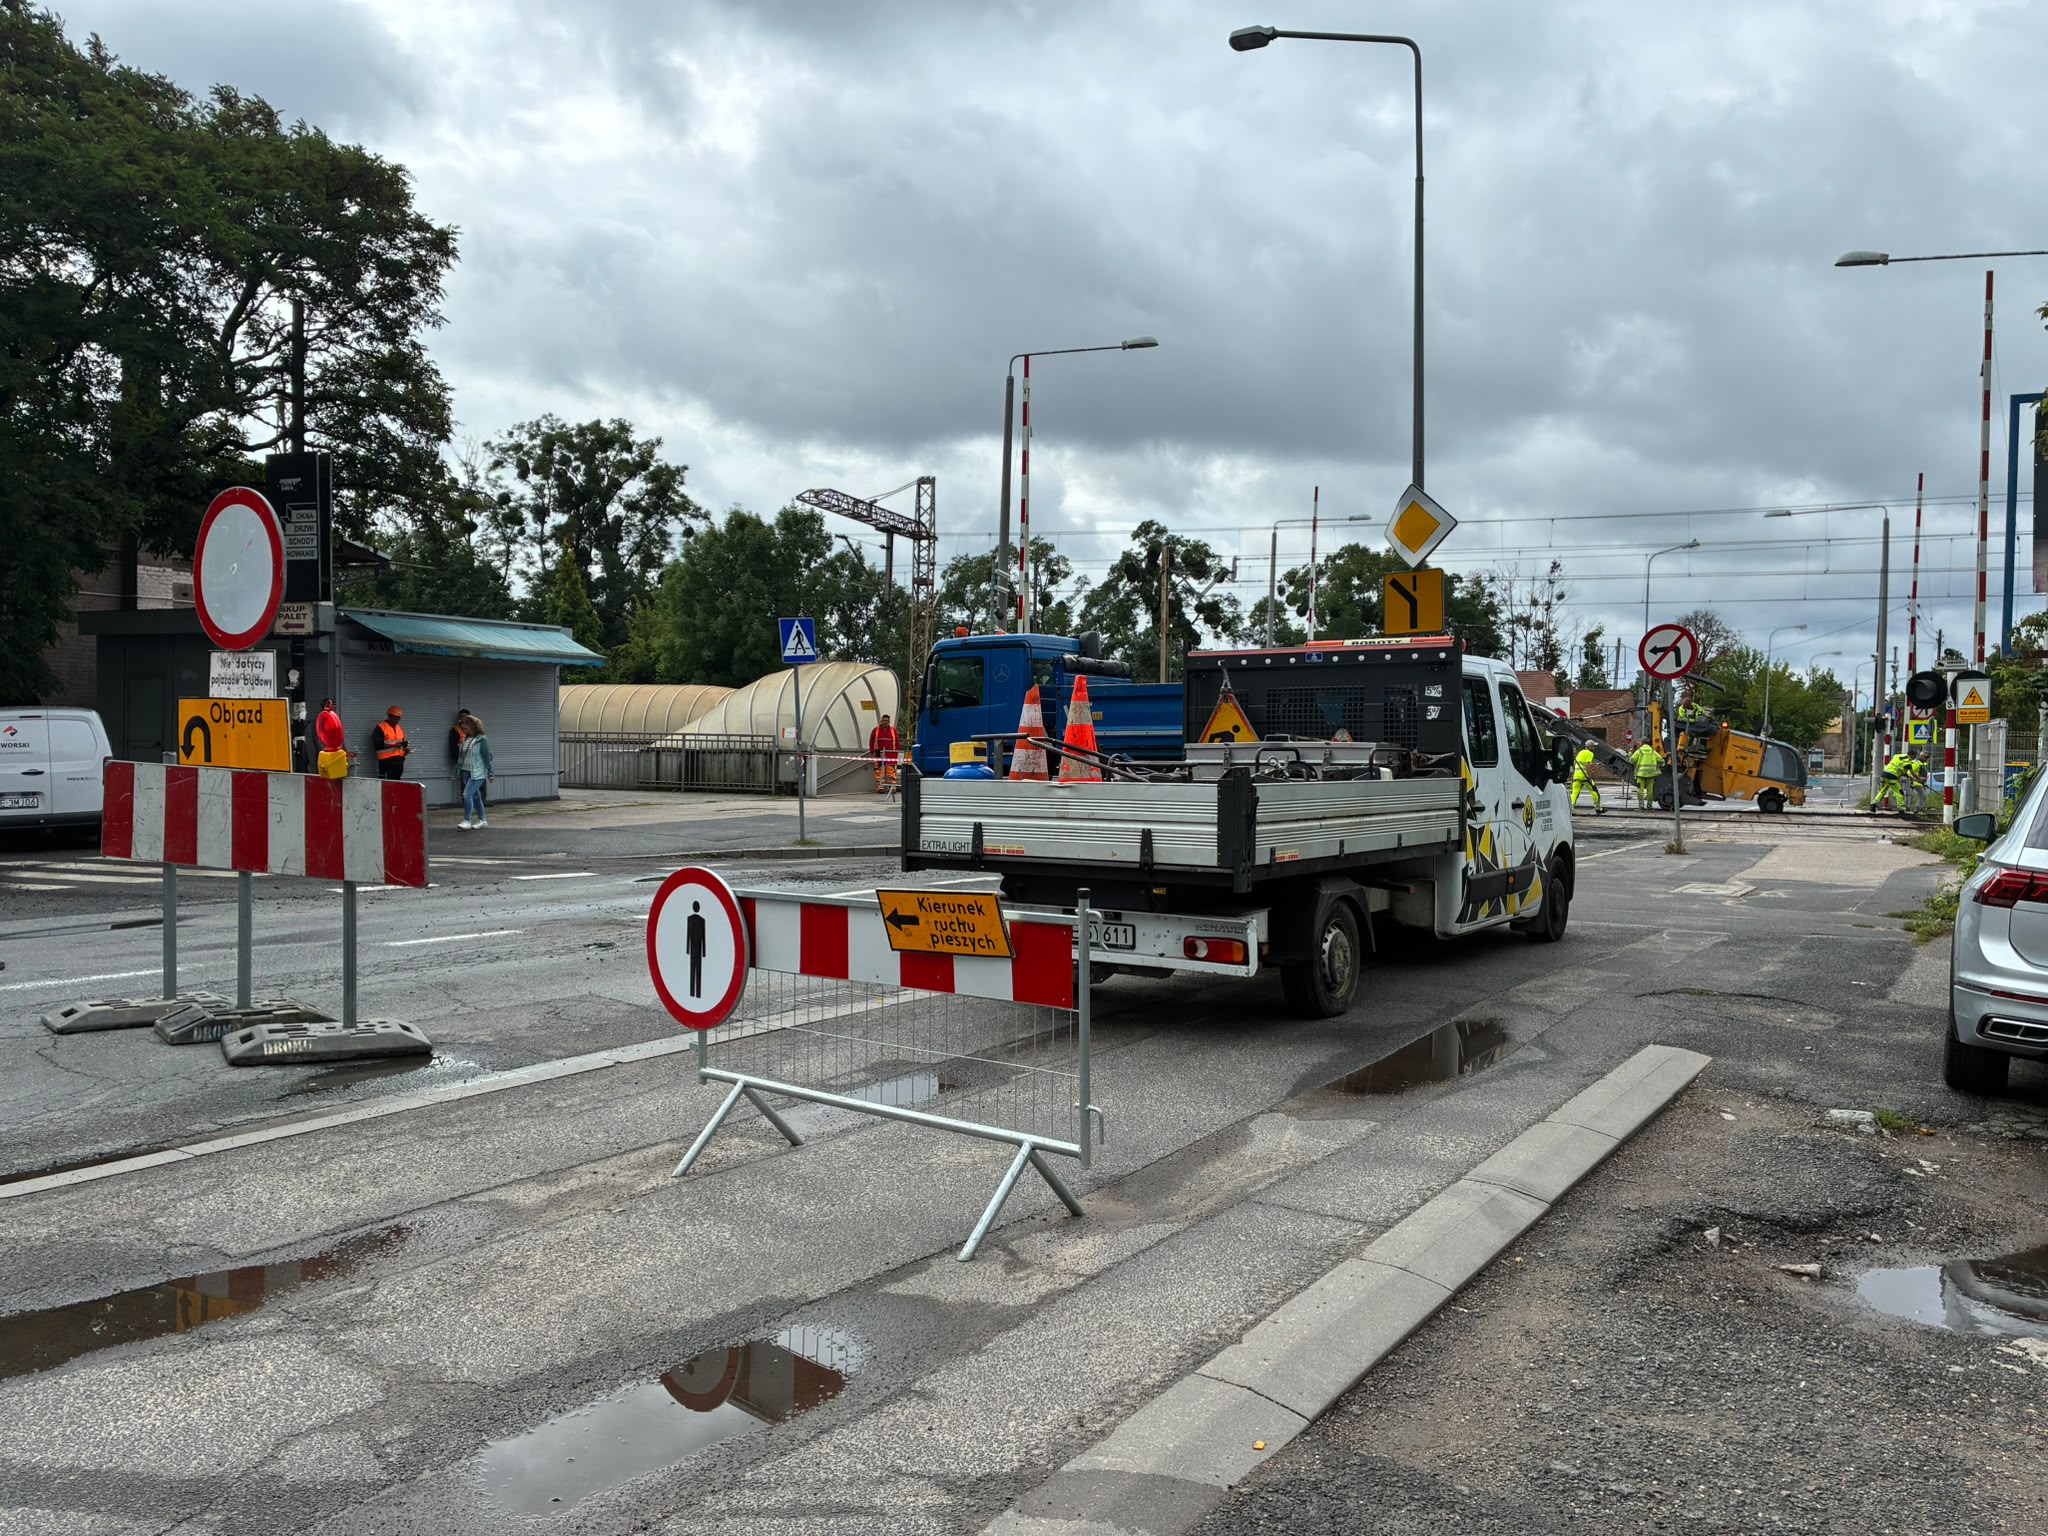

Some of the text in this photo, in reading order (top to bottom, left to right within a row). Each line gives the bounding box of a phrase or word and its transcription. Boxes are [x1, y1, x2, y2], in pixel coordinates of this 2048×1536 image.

[295, 512, 314, 520] OKNA
[294, 525, 315, 533] DRZWI
[288, 537, 314, 545] SCHODY
[236, 658, 265, 672] dotyczy
[243, 676, 272, 690] budowy
[210, 702, 263, 728] Objazd
[921, 840, 947, 851] EXTRA
[948, 841, 971, 852] LIGHT
[917, 897, 985, 916] Kierunek
[934, 917, 976, 933] ruchu
[930, 930, 996, 952] pieszych
